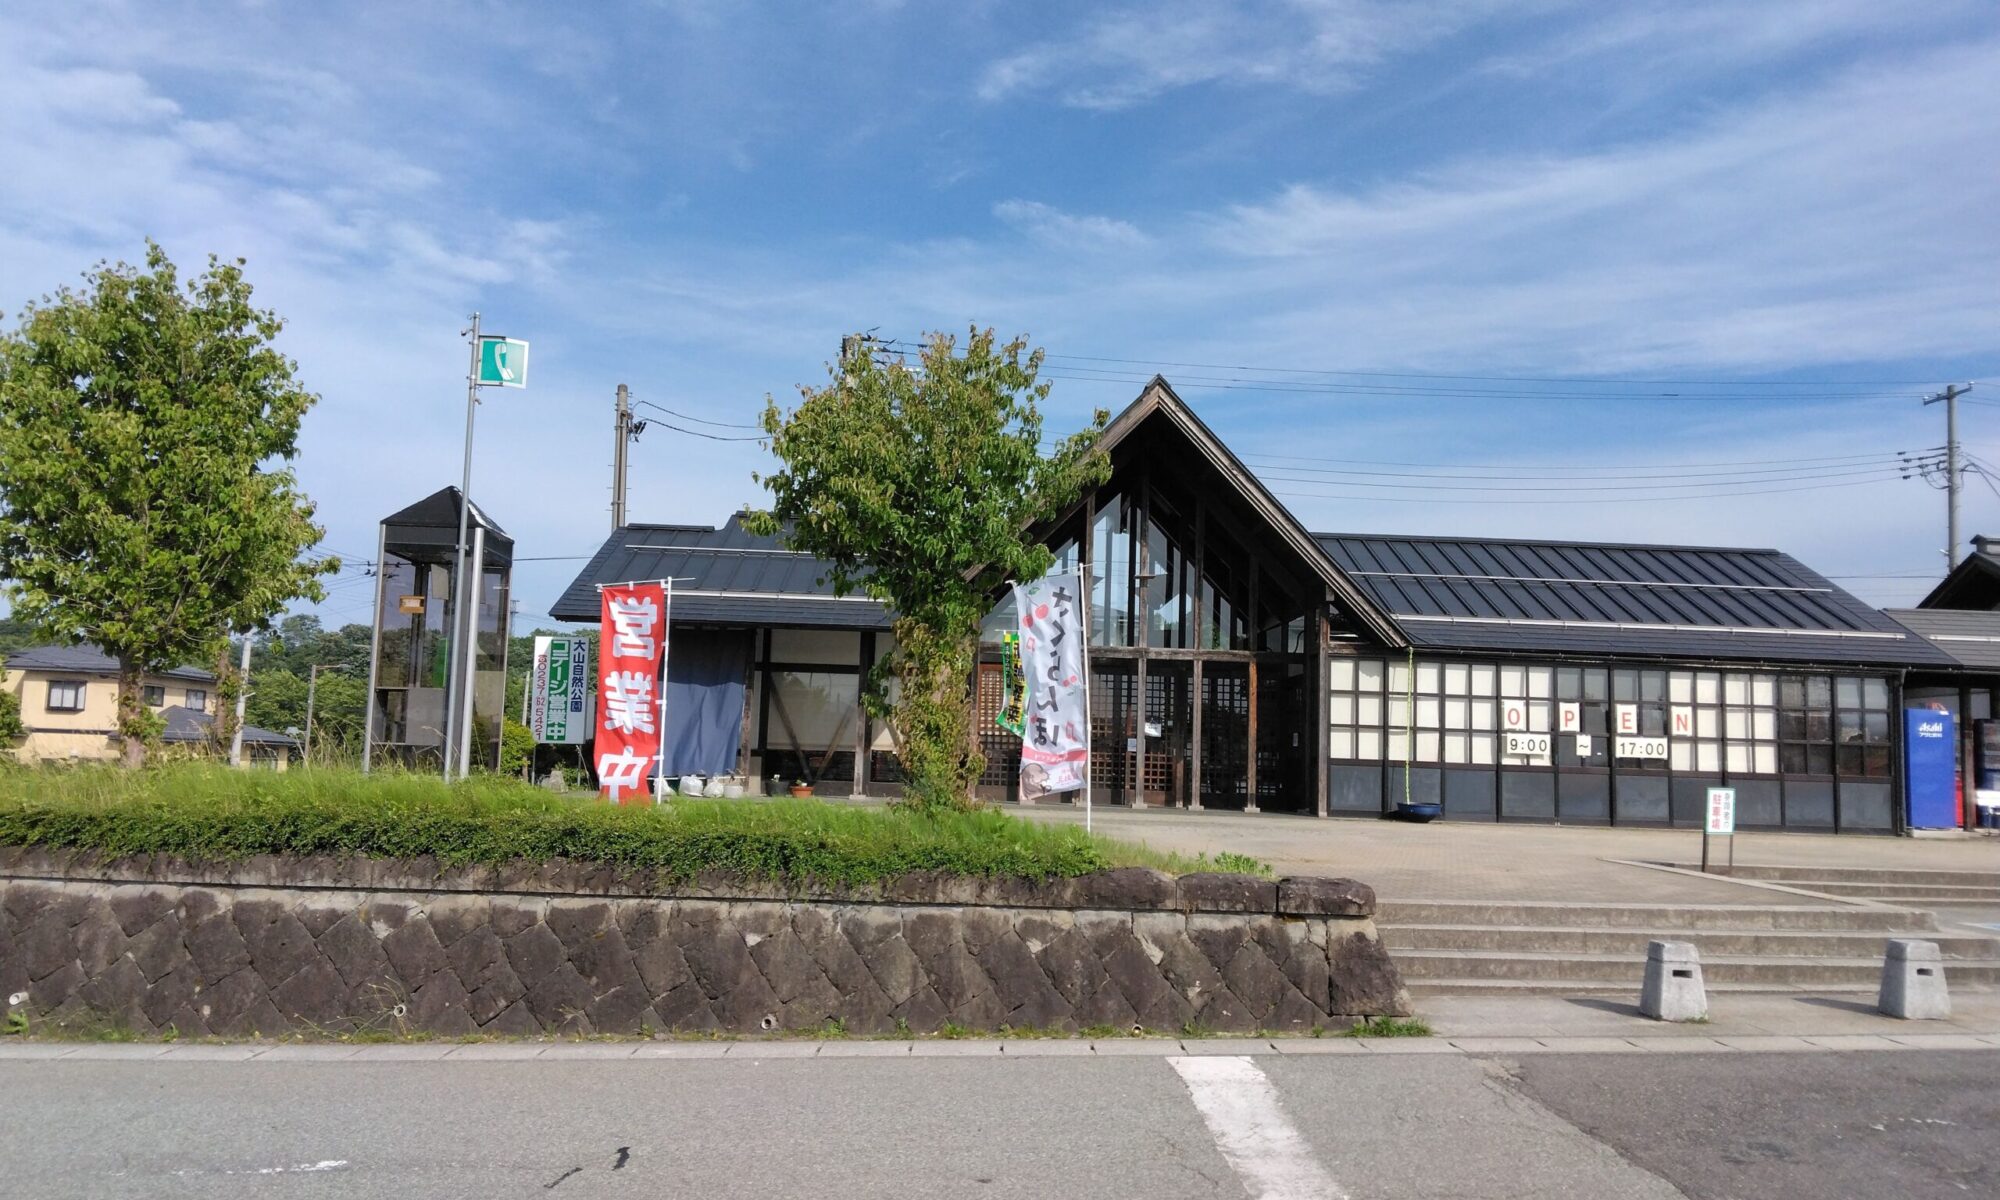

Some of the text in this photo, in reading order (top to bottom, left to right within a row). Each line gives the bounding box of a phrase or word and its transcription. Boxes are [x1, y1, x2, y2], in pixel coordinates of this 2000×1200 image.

[547, 640, 570, 740] コテージ営業中
[570, 639, 586, 713] 大山自然公園
[1507, 708, 1689, 732] OPEN
[1919, 722, 1943, 731] Asahi
[1509, 738, 1548, 752] 9:00
[1620, 742, 1665, 756] 17:00
[1711, 793, 1722, 830] 駐車場
